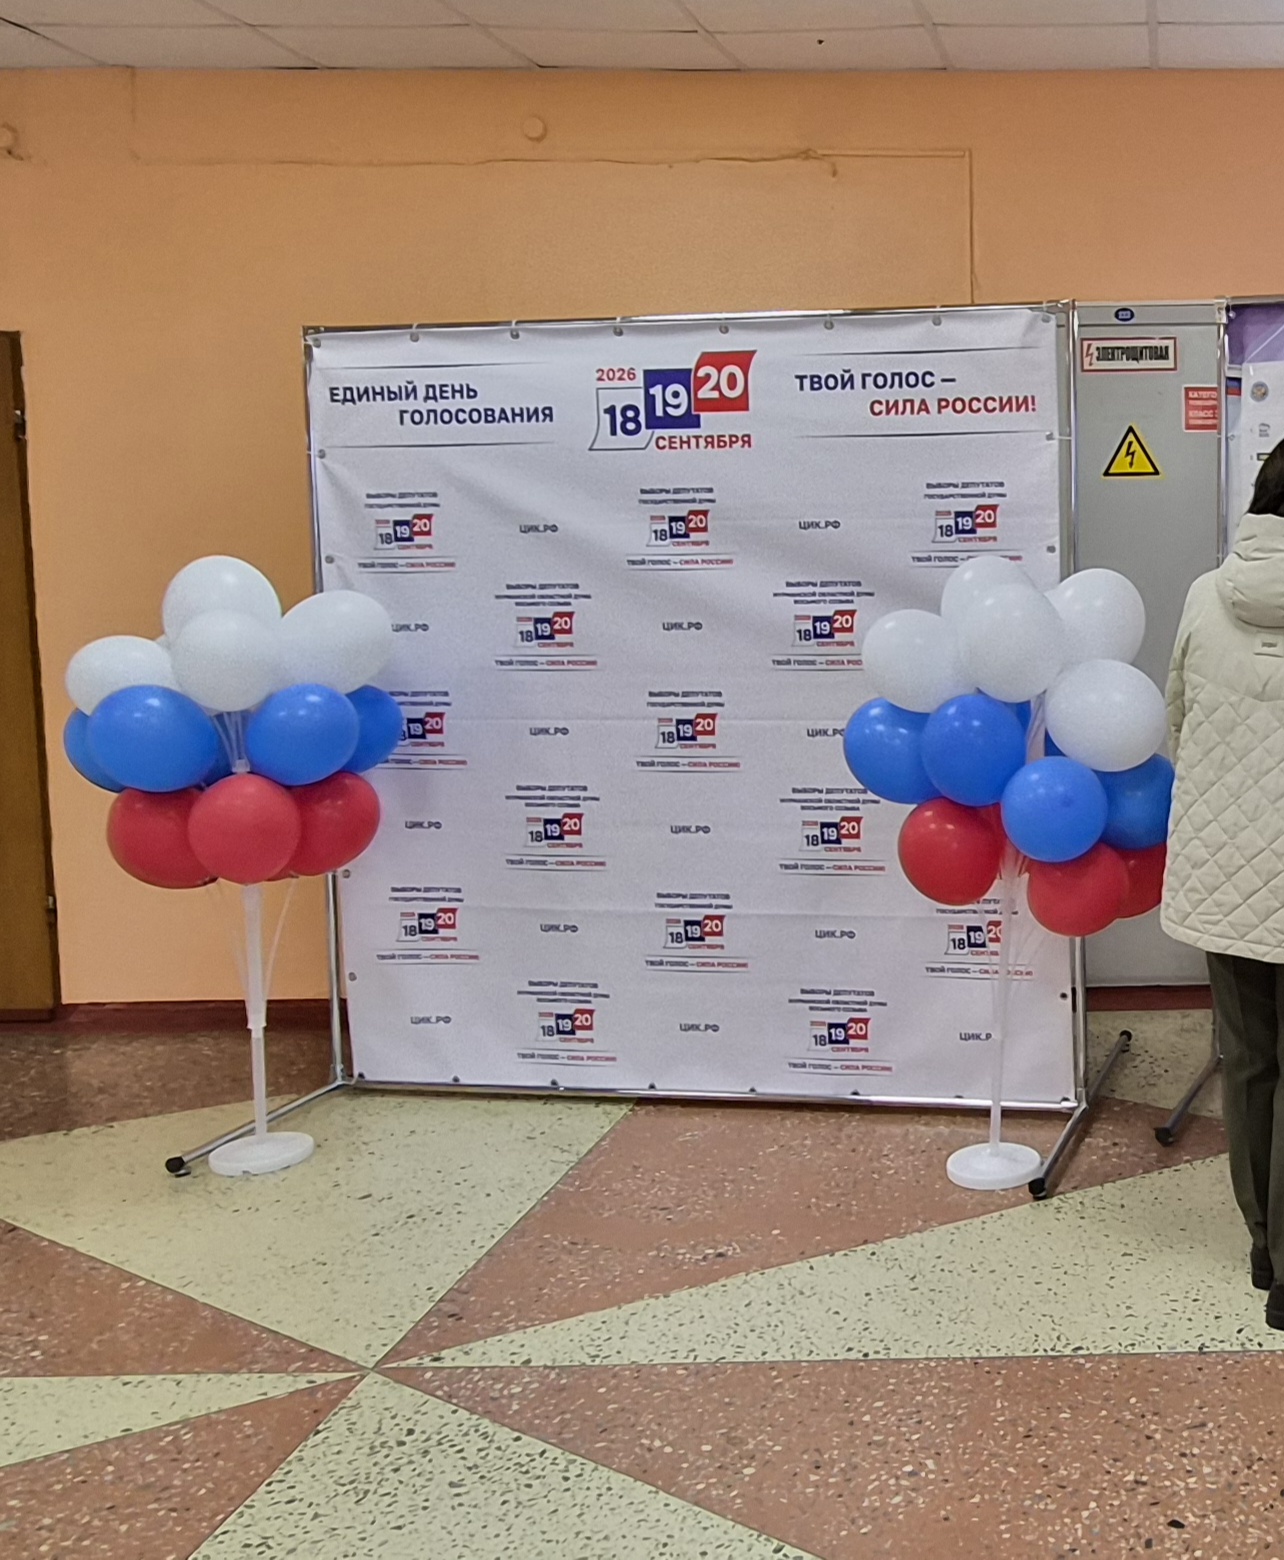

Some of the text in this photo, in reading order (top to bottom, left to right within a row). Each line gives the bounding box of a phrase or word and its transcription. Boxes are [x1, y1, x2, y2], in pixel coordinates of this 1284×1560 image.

[1095, 345, 1170, 363] ЭЛЕКТРОЩИТОВАЯ
[596, 367, 636, 382] 2026
[794, 368, 855, 392] ТВОЙ
[861, 370, 935, 390] ГОЛОС
[329, 380, 478, 405] ЕДИНЫЙ ДЕНЬ
[602, 364, 744, 437] 18 19 20
[399, 406, 554, 426] ГОЛОСОВАНИЯ
[869, 395, 1036, 417] СИЛА РОССИИ!
[655, 433, 752, 450] СЕНТЯБРЯ
[412, 518, 430, 532] 20
[652, 515, 706, 542] 18 19 20
[938, 509, 995, 537] 18 19 20
[553, 616, 571, 629] 20
[796, 614, 852, 641] 18 19 20
[660, 718, 714, 744] 18 19 20
[563, 818, 580, 830] 20
[804, 821, 858, 847] 18 19 20
[437, 913, 454, 925] 20
[669, 920, 721, 944] 18 19 20
[951, 937, 966, 950] 18
[969, 930, 984, 943] 19
[574, 1013, 592, 1026] 20
[813, 1023, 866, 1047] 18 19 20
[959, 1032, 992, 1041] ЦИК.Р
